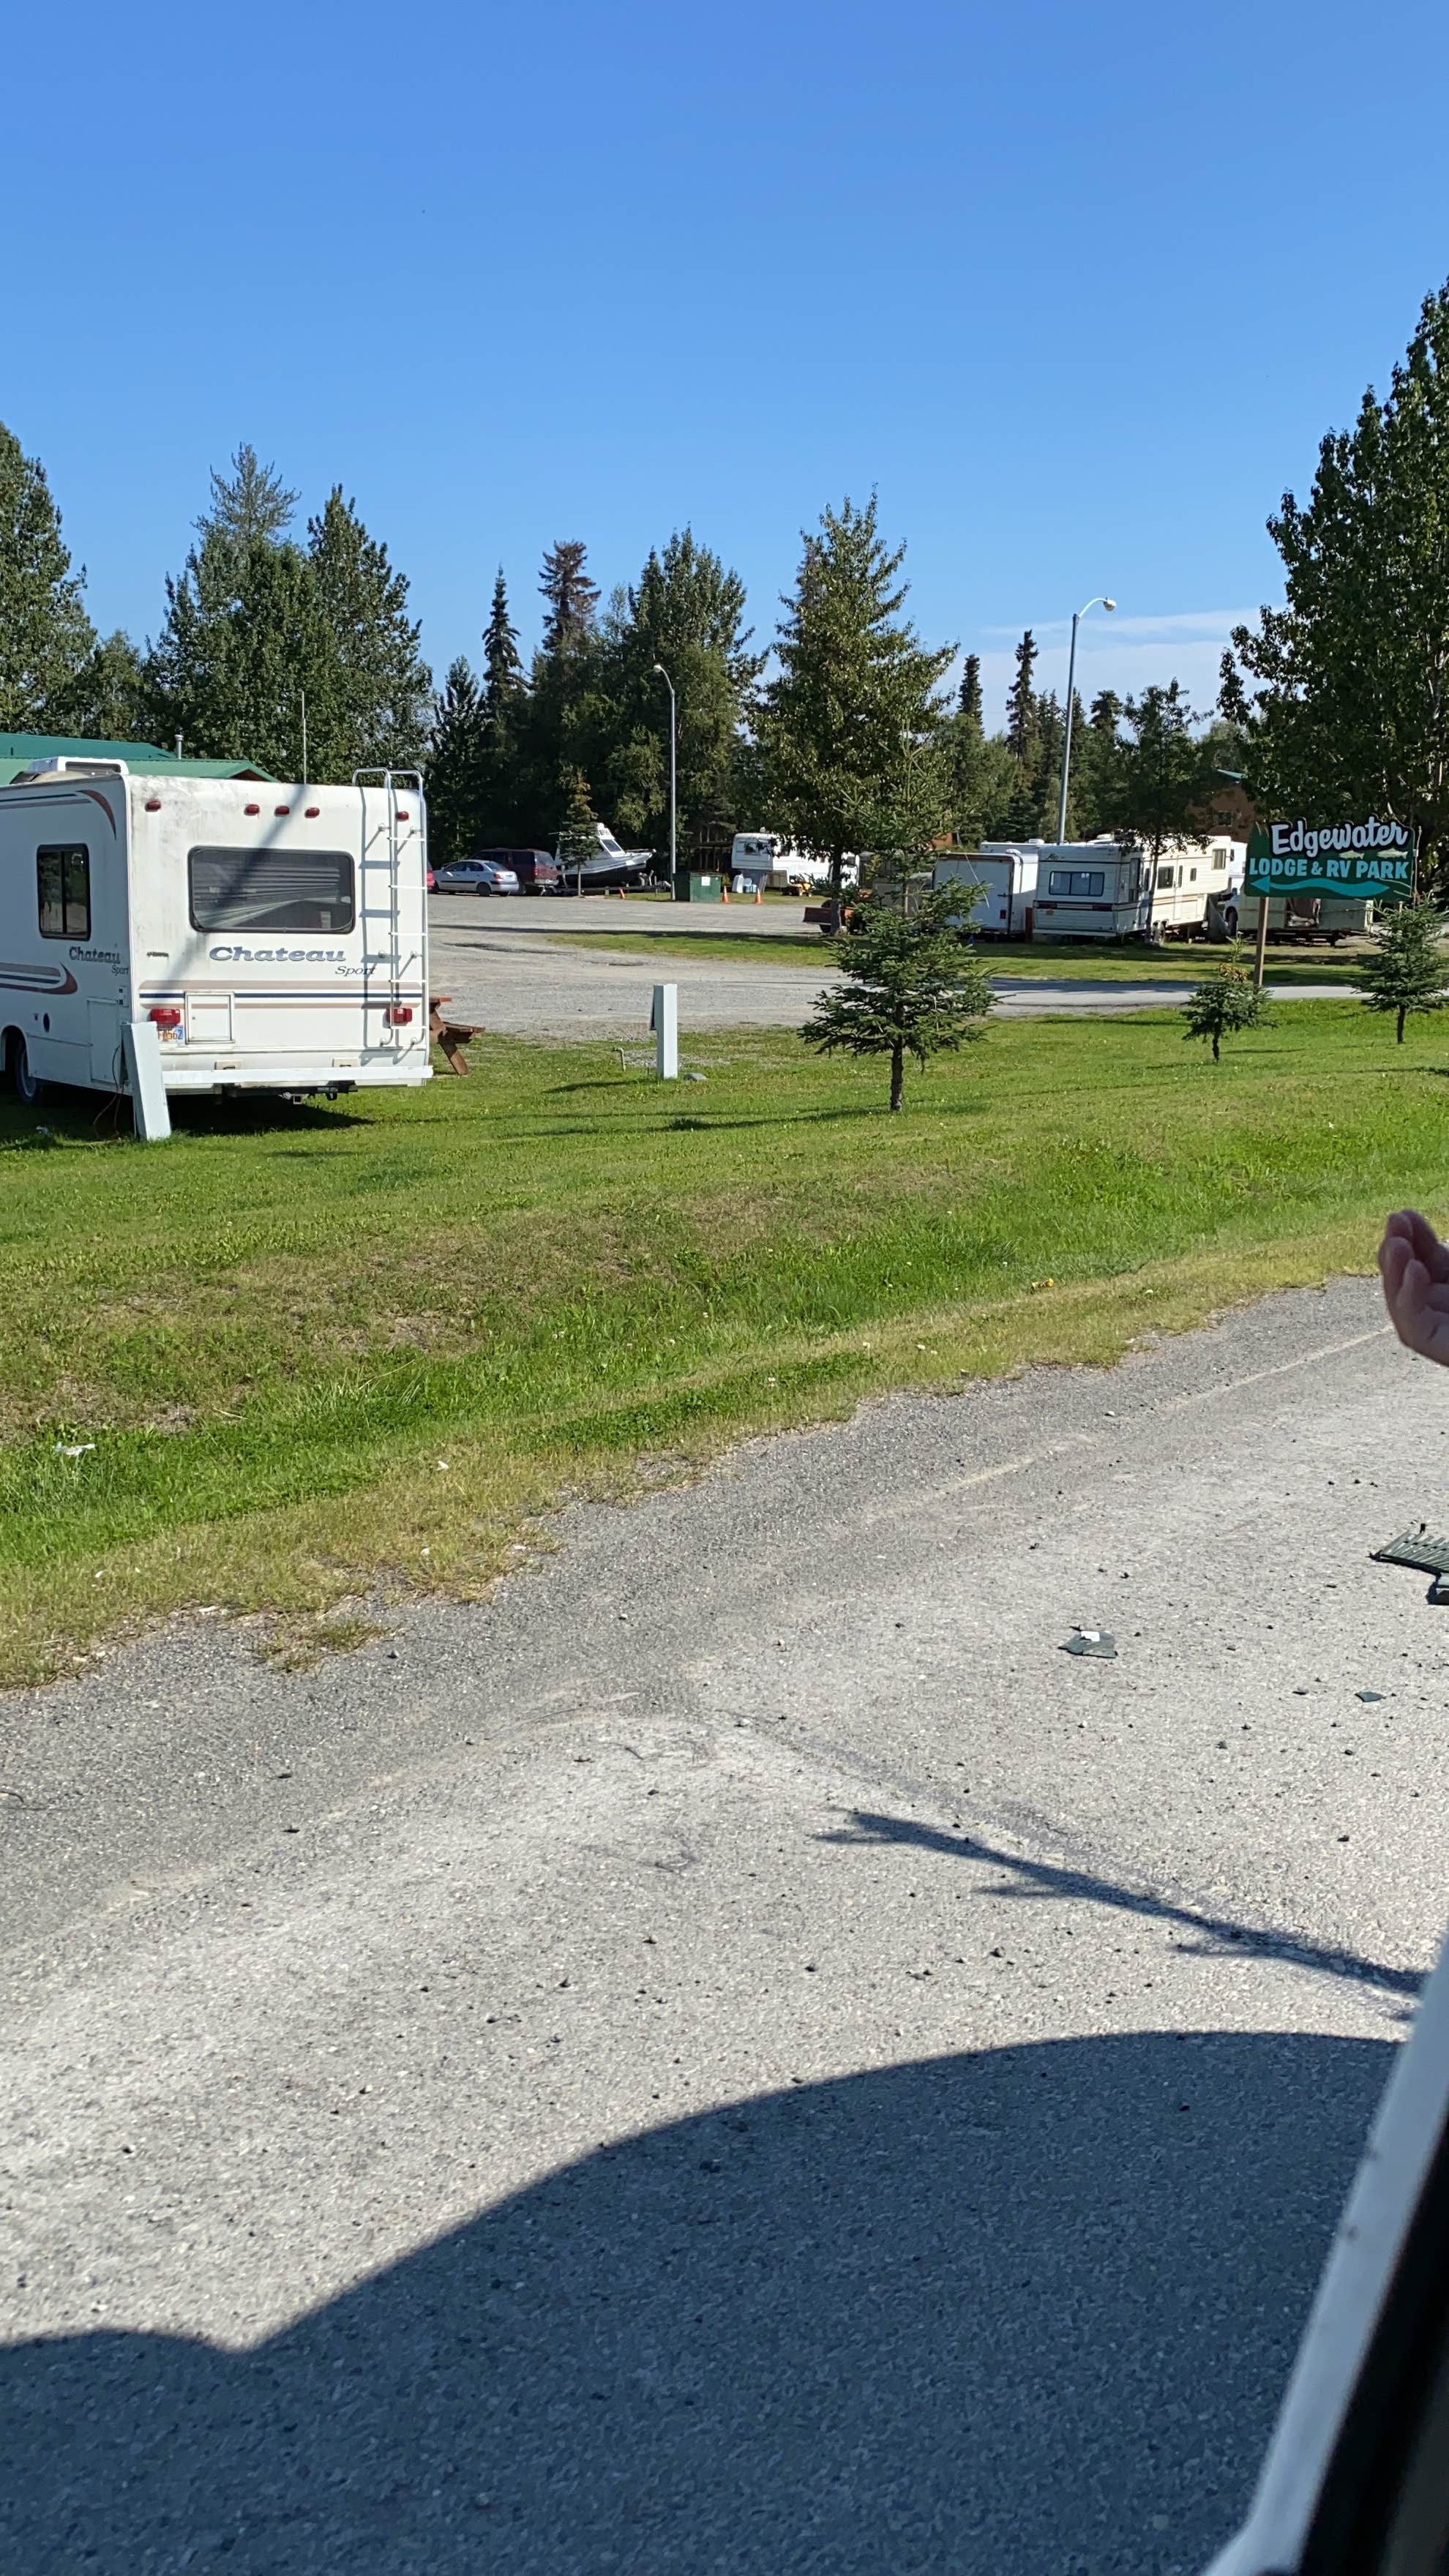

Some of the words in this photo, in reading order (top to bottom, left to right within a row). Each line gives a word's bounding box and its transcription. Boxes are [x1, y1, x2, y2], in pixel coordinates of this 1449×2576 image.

[1271, 816, 1409, 858] Edgewater
[1248, 858, 1308, 877] LODGE
[1311, 862, 1324, 876] &
[1326, 859, 1352, 877] RV
[1355, 860, 1409, 879] PARK
[70, 946, 121, 964] Chateau
[209, 946, 346, 962] Chateau
[111, 965, 129, 976] Sport
[334, 965, 376, 976] Sport
